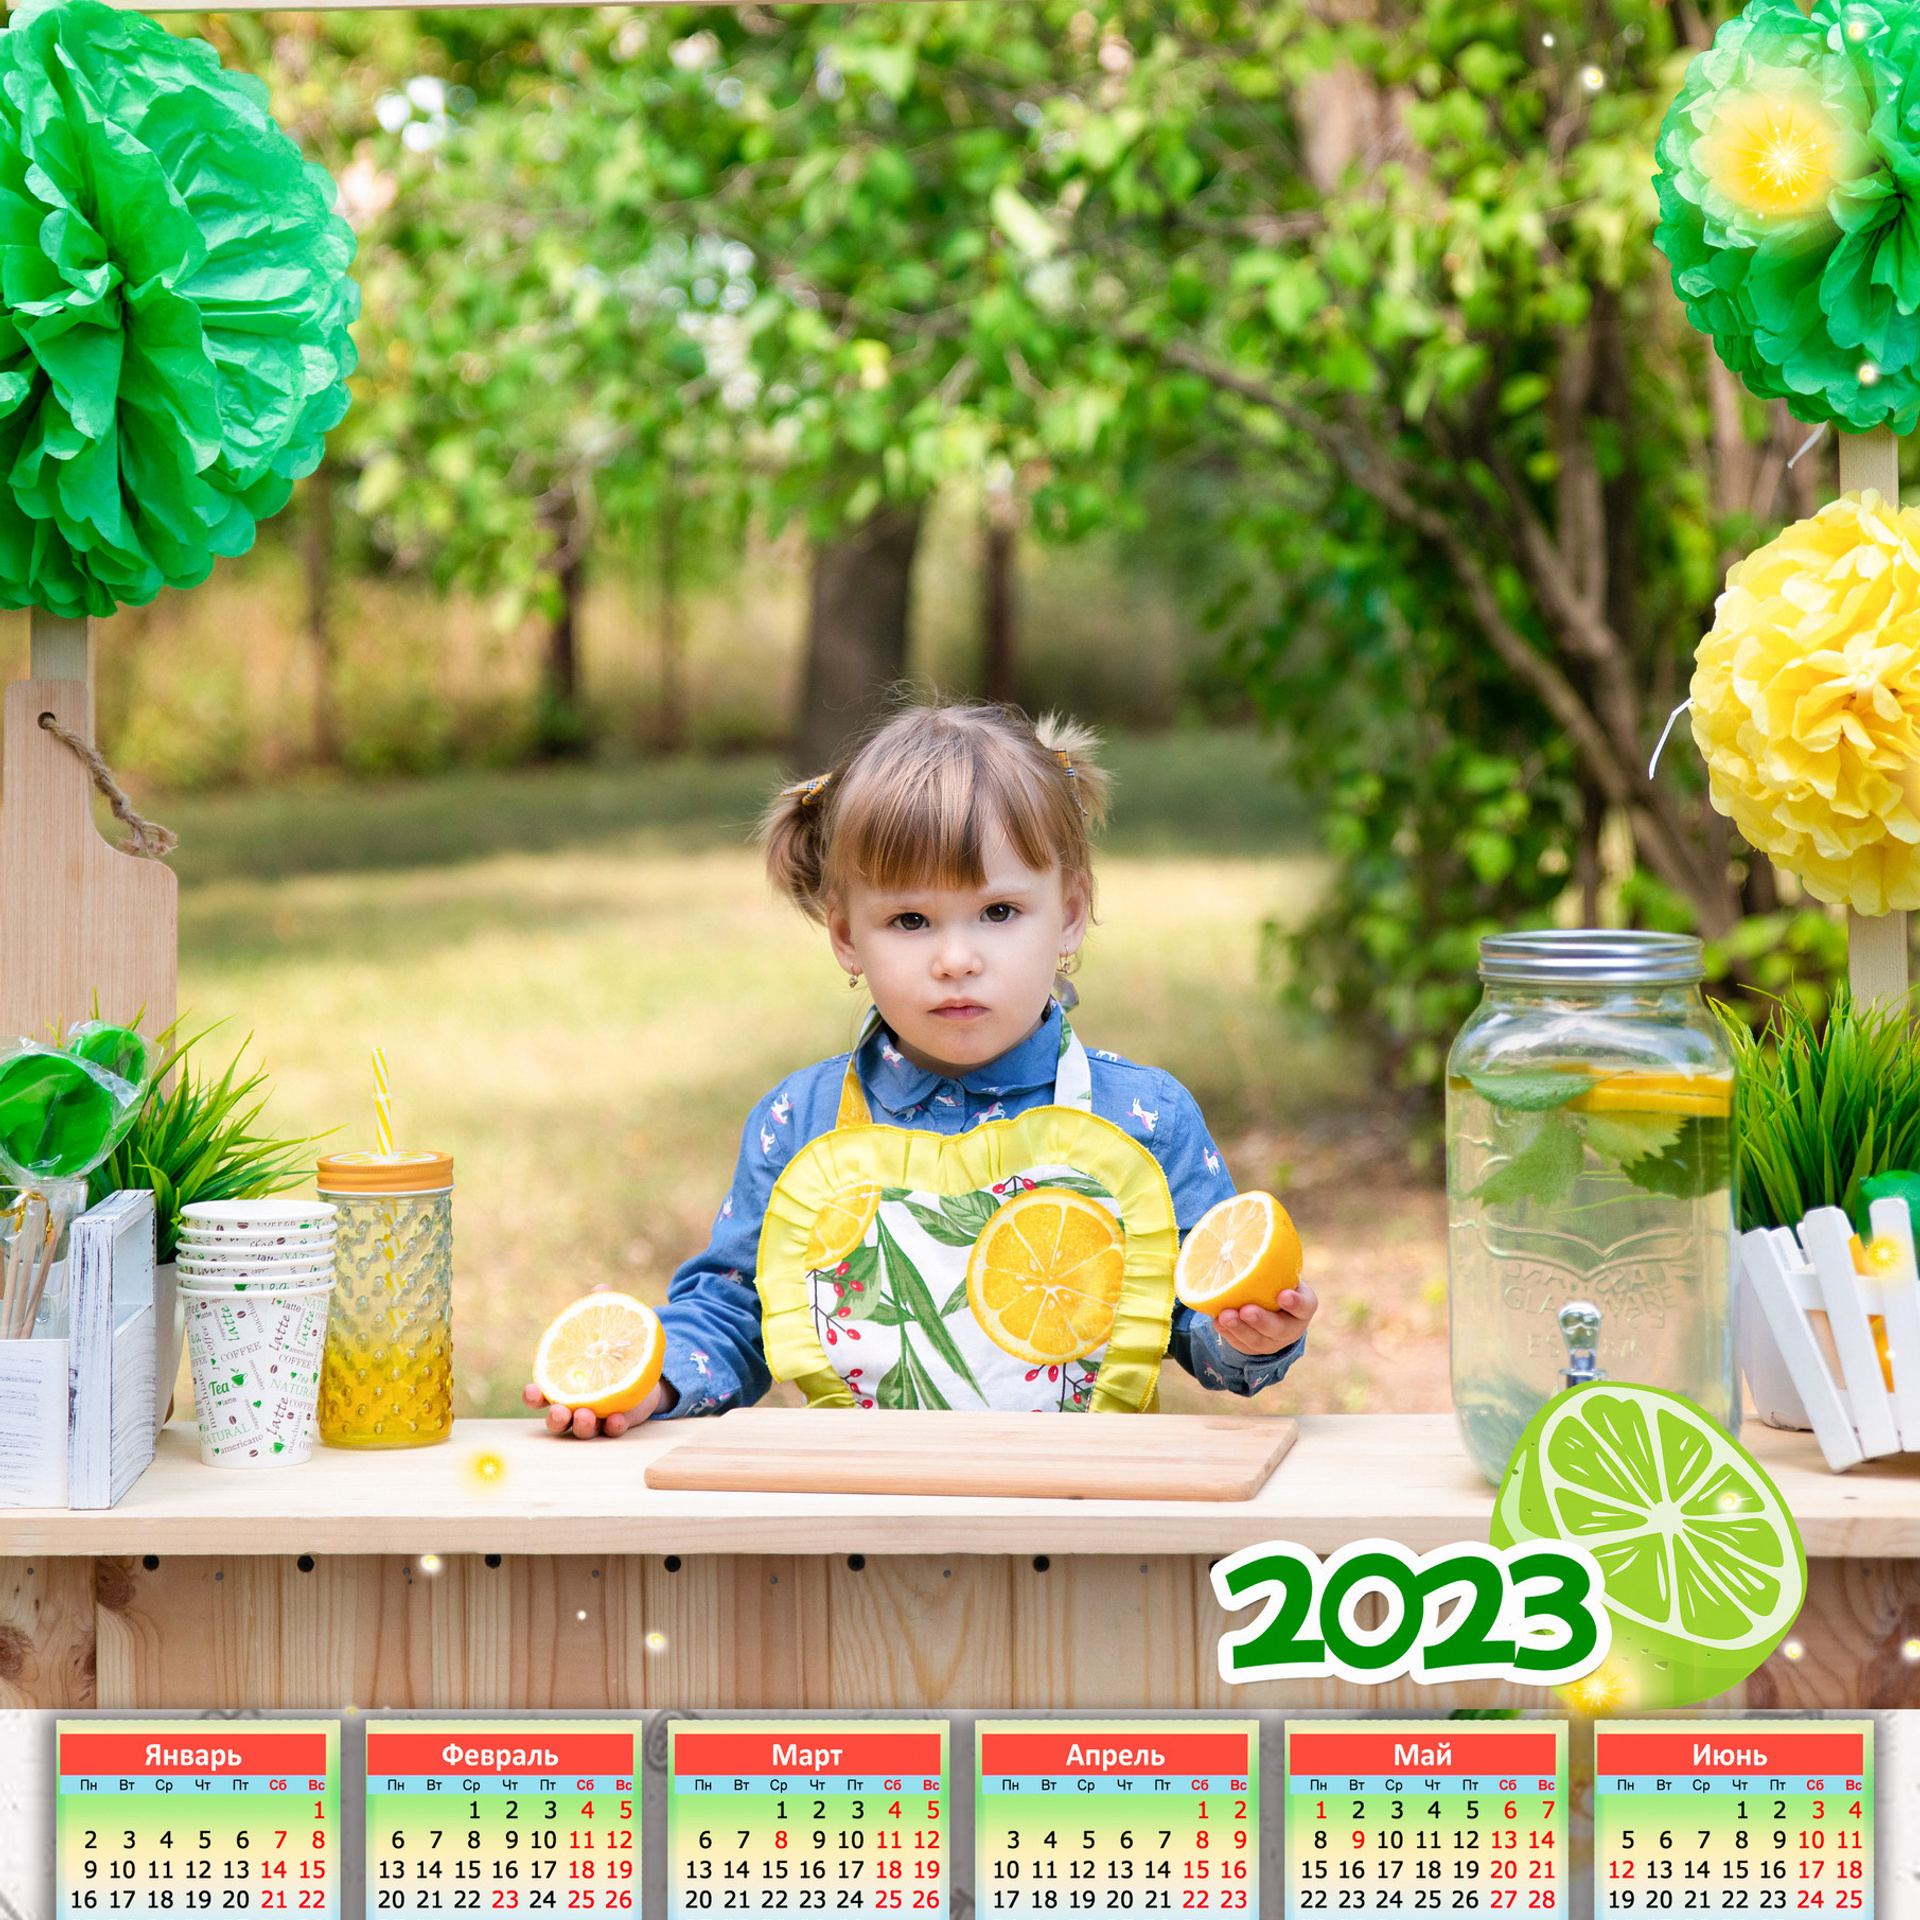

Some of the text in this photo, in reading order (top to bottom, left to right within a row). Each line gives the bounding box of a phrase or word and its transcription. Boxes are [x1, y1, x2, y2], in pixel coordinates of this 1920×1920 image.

[282, 1300, 302, 1313] latte
[221, 1305, 240, 1341] latte
[269, 1315, 290, 1351] latte
[297, 1310, 314, 1347] latte
[202, 1325, 216, 1356] coffee
[220, 1341, 262, 1362] COFFEE
[279, 1354, 312, 1369] COFFEE
[208, 1380, 230, 1396] Tea
[289, 1398, 314, 1411] COFFEE
[266, 1397, 288, 1435] latte
[201, 1423, 250, 1446] NATURAL
[220, 1434, 264, 1454] americano
